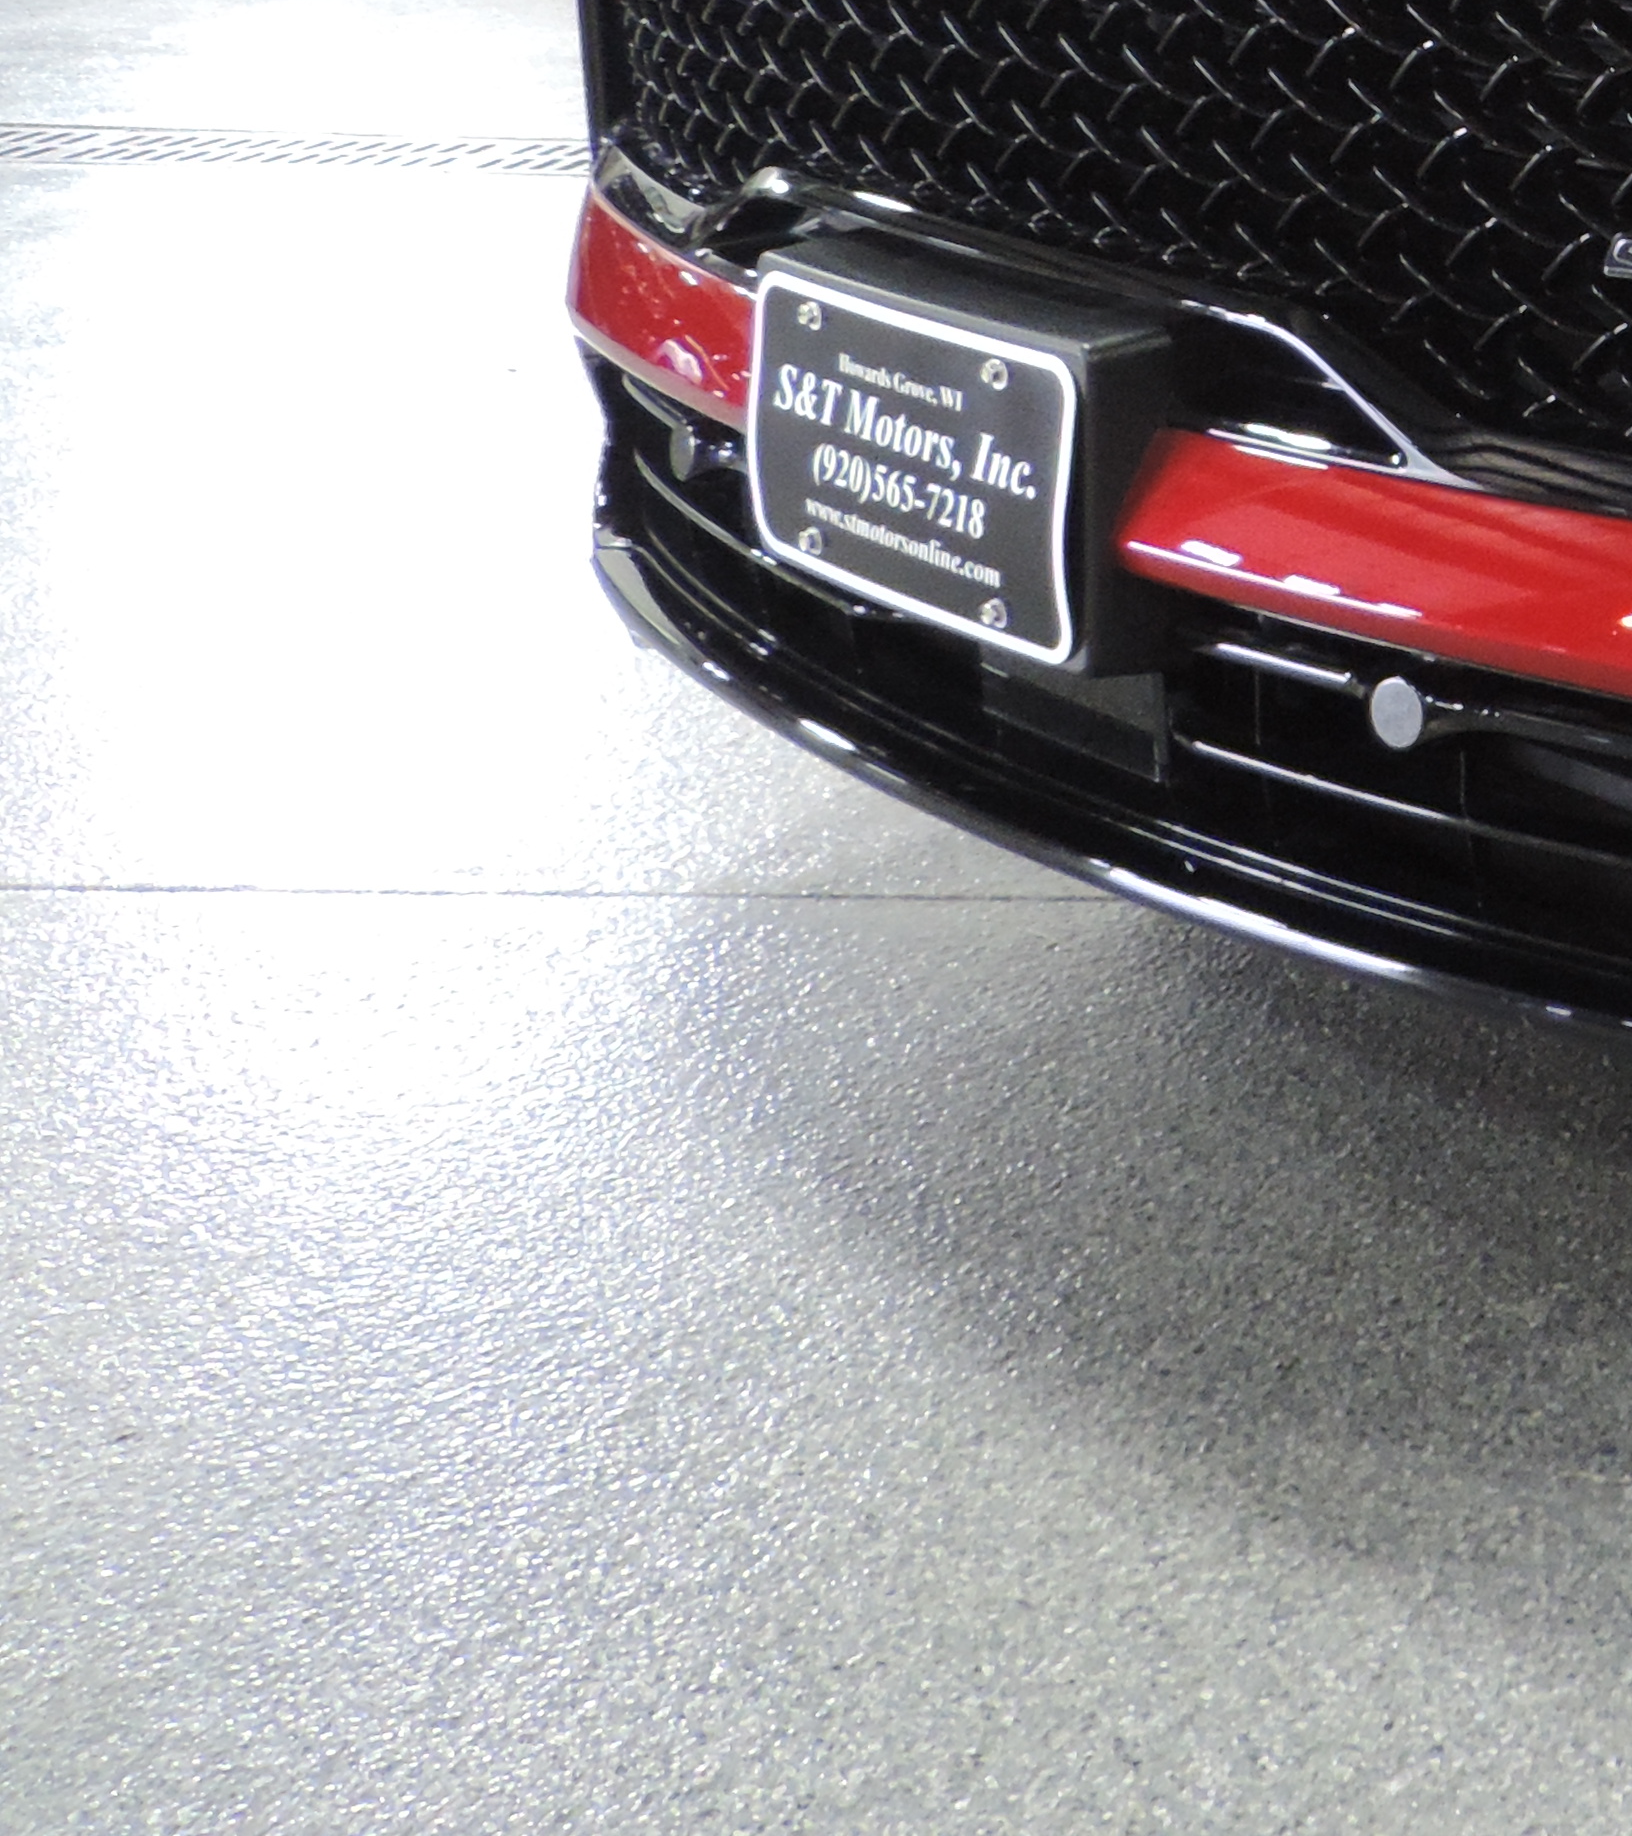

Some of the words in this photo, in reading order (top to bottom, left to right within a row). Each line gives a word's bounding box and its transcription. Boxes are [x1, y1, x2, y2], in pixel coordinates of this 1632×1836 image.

[838, 351, 892, 390] Howards
[893, 371, 938, 407] Grove,
[939, 384, 963, 413] WI
[773, 363, 843, 428] S&T
[844, 390, 964, 481] Motors,
[970, 432, 1038, 500] Inc.
[812, 443, 986, 540] (920)565-7218
[804, 497, 1002, 589] www.stmotorsonline.com
